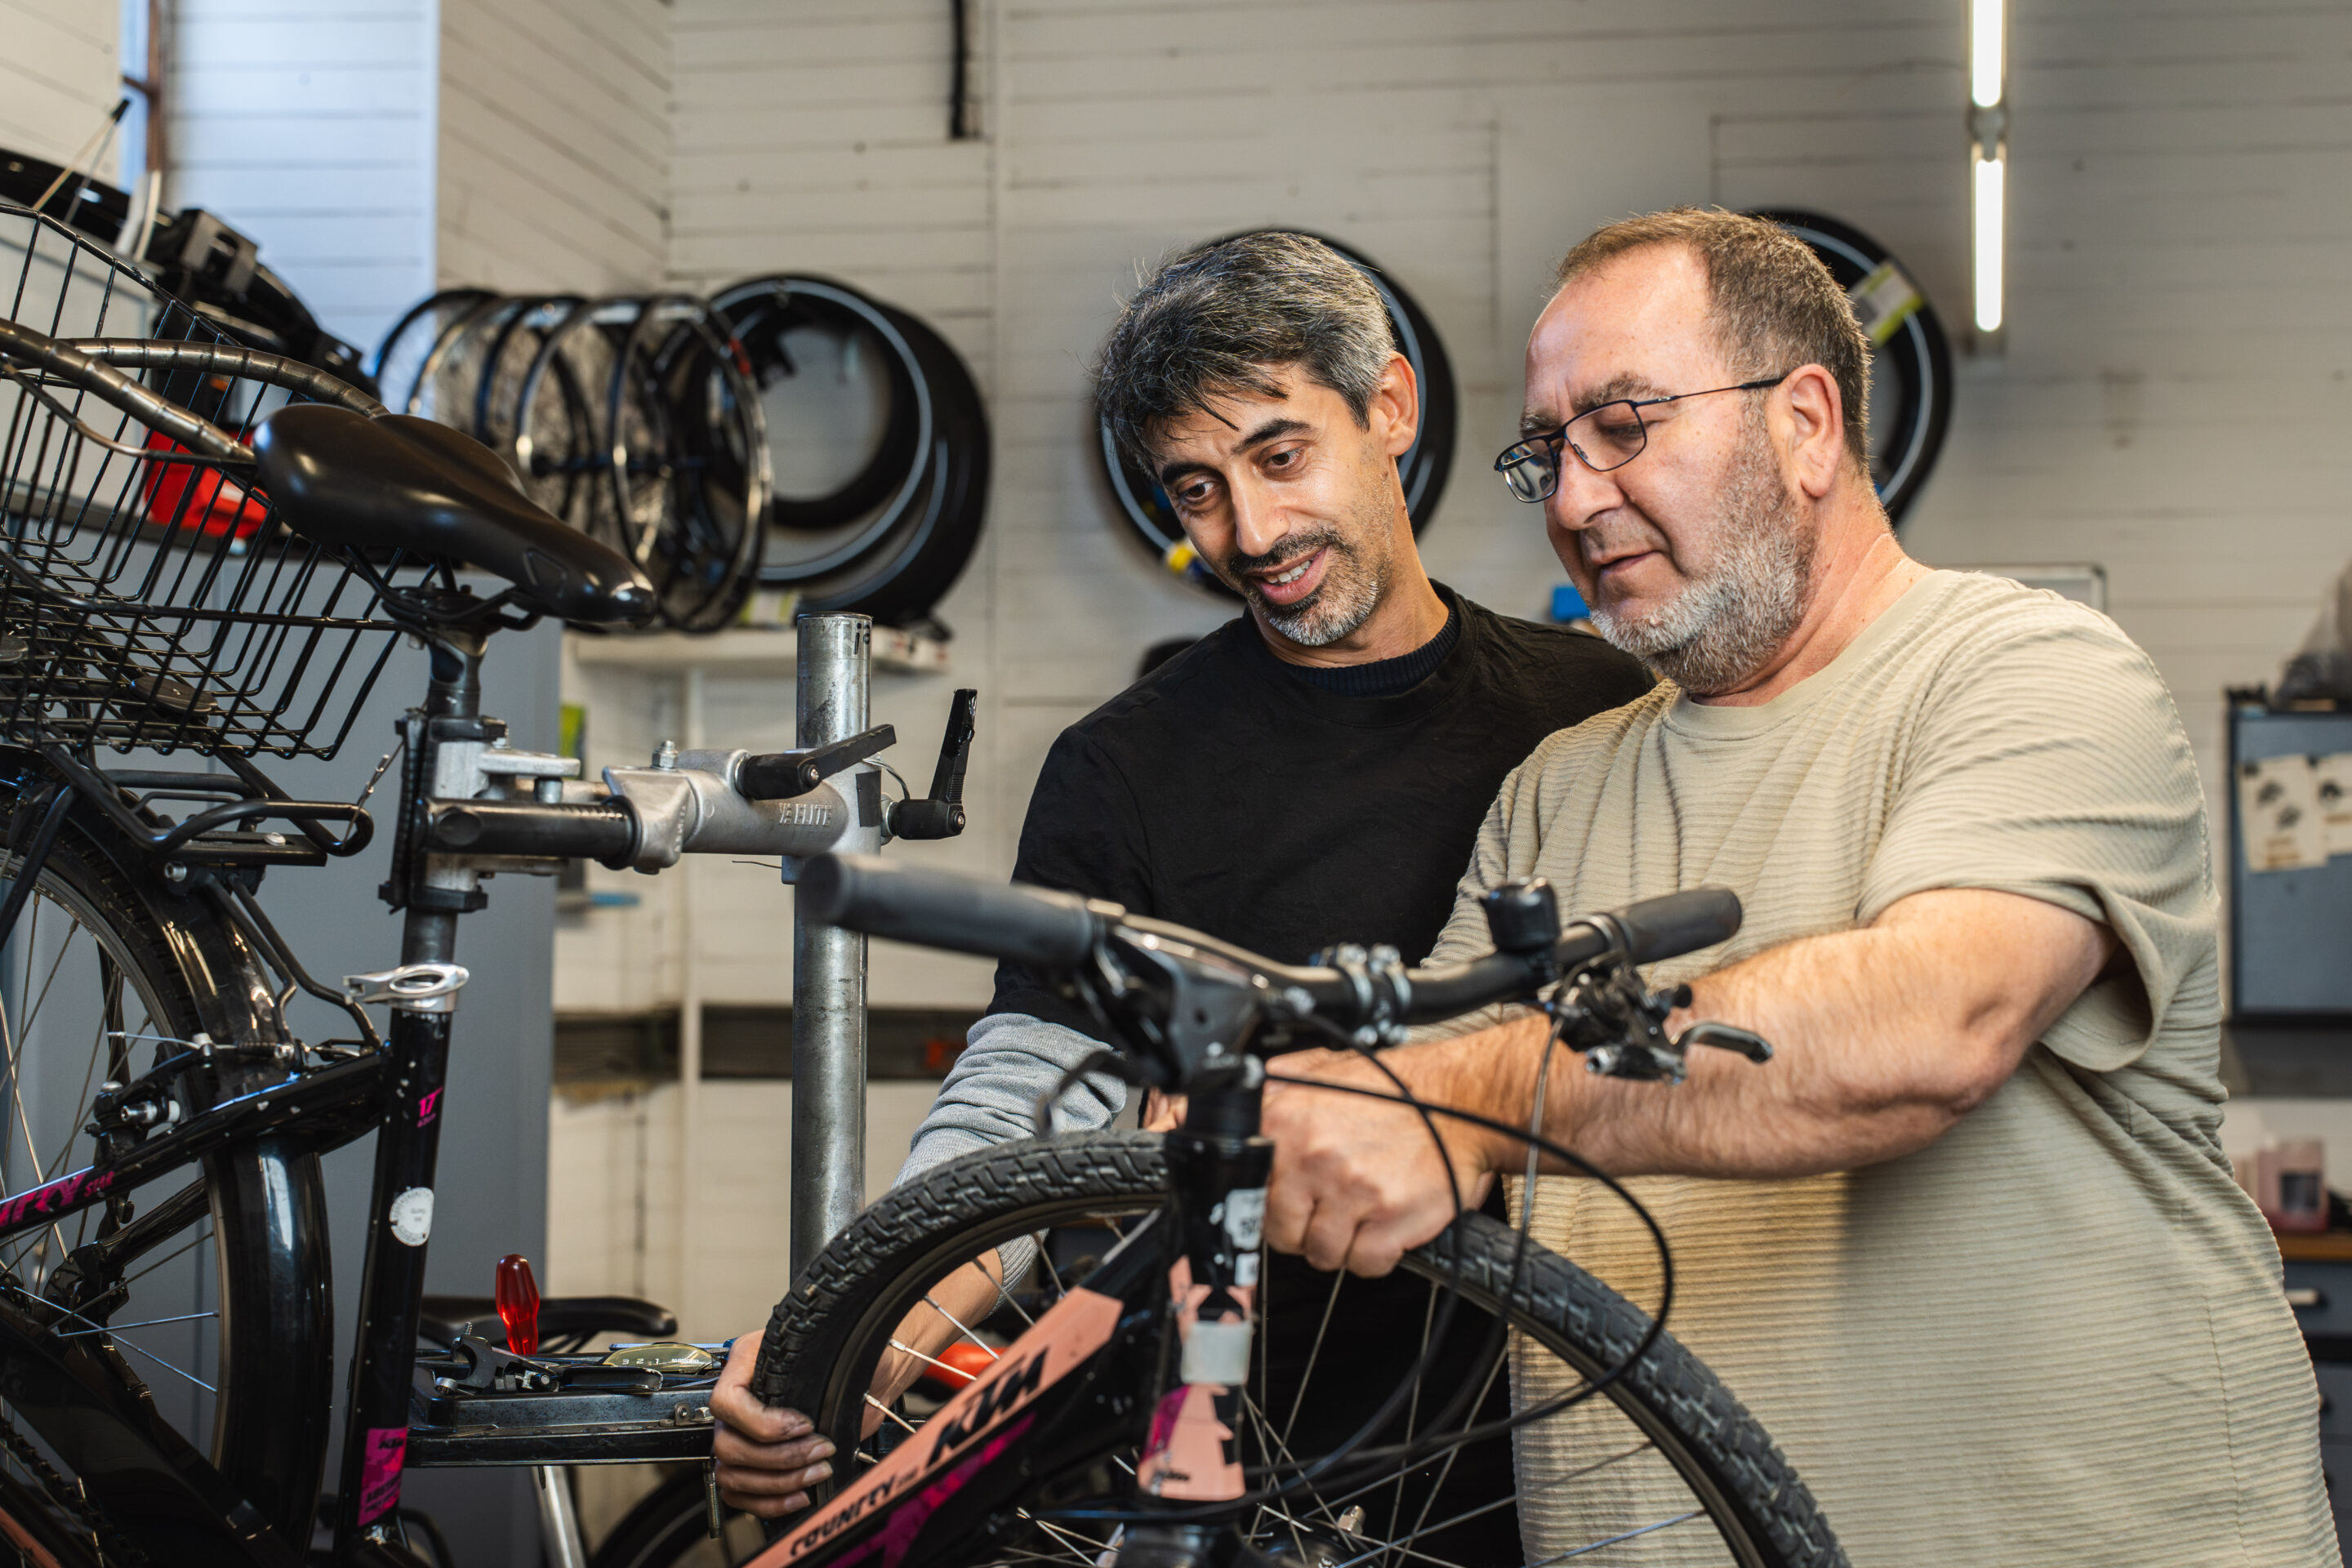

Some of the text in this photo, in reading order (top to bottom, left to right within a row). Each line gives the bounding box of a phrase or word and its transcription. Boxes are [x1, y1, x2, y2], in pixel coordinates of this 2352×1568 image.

[794, 803, 832, 826] ELITE
[418, 1085, 443, 1117] 17
[83, 1170, 115, 1198] STAR
[925, 1345, 1051, 1470] KTM
